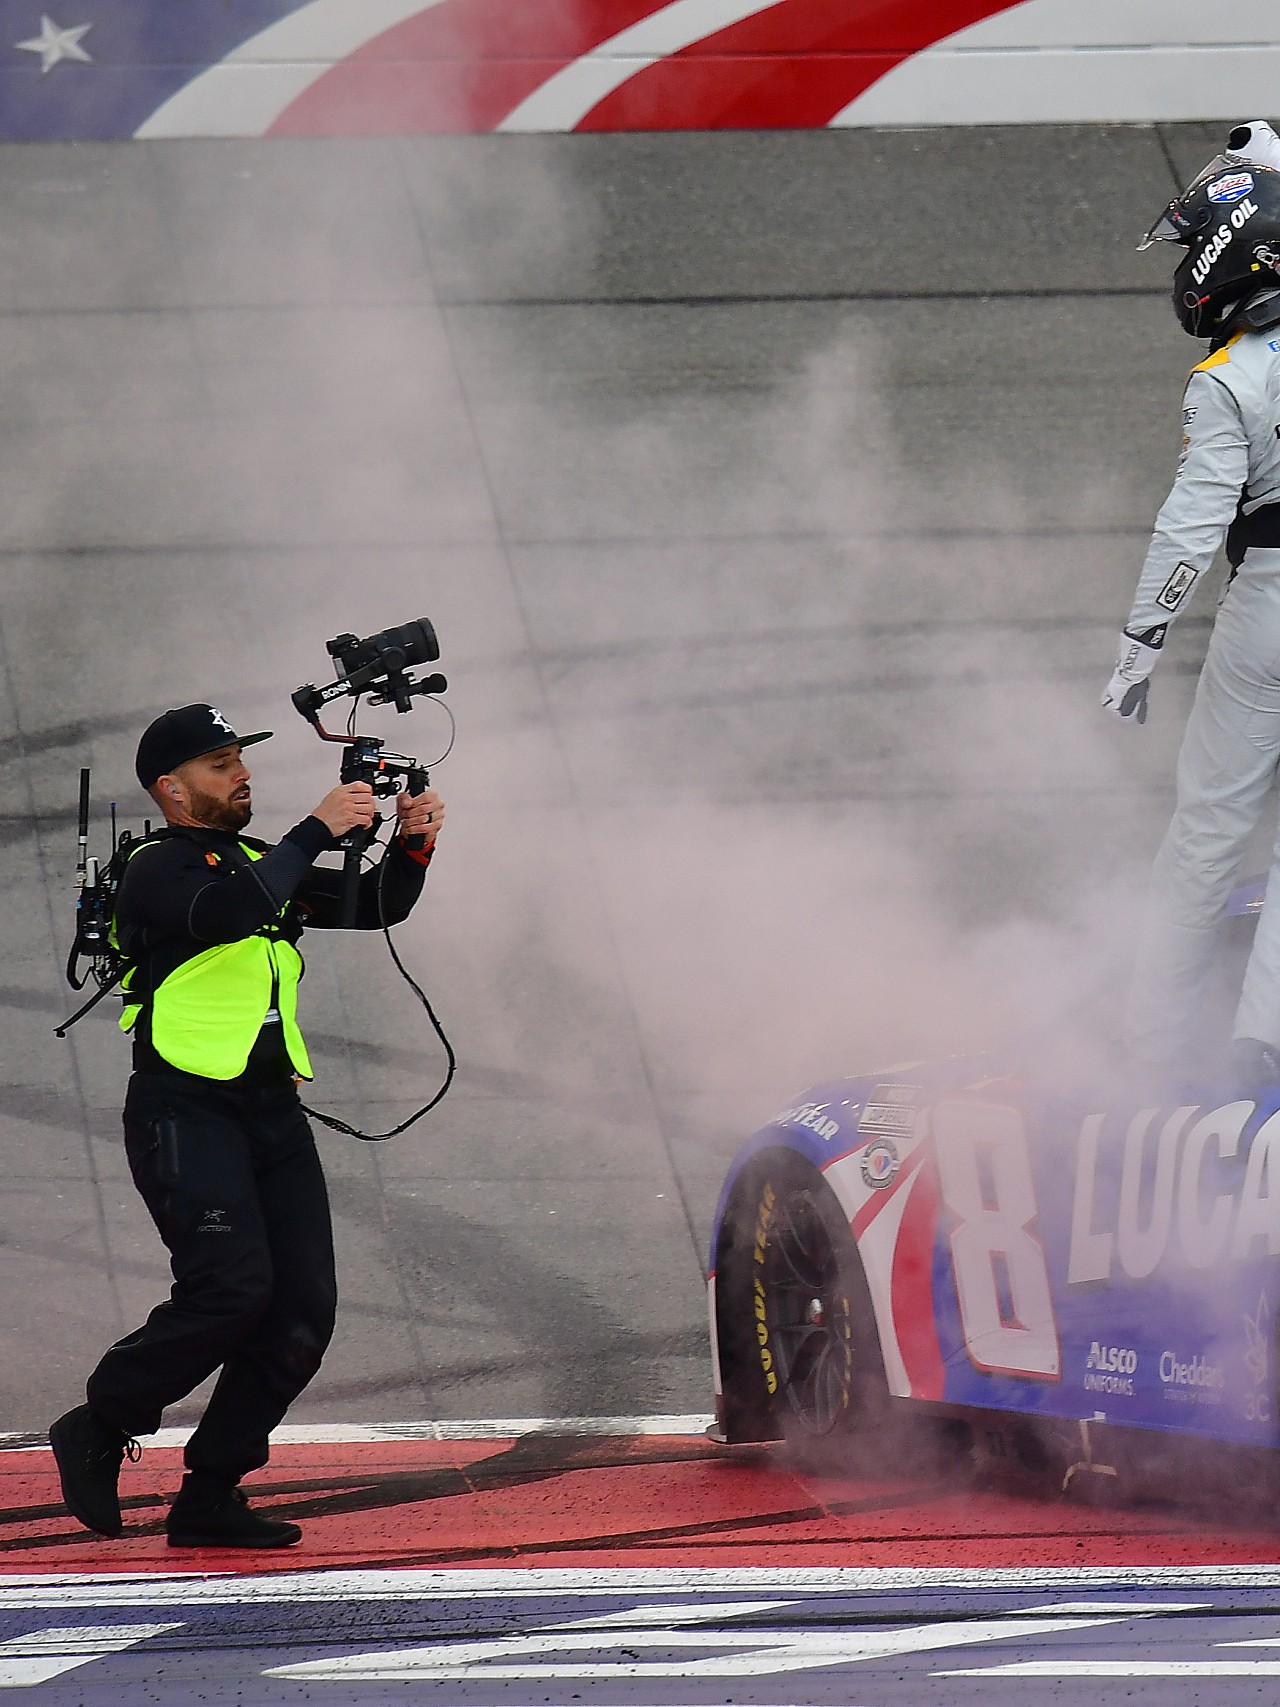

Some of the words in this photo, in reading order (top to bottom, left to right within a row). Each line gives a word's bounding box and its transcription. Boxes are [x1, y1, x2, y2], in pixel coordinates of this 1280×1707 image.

[1191, 224, 1232, 285] LUCAS
[1230, 198, 1259, 229] OIL
[321, 680, 352, 700] RONIN
[930, 1103, 1062, 1382] 8
[1084, 1373, 1134, 1397] UNIFORMS
